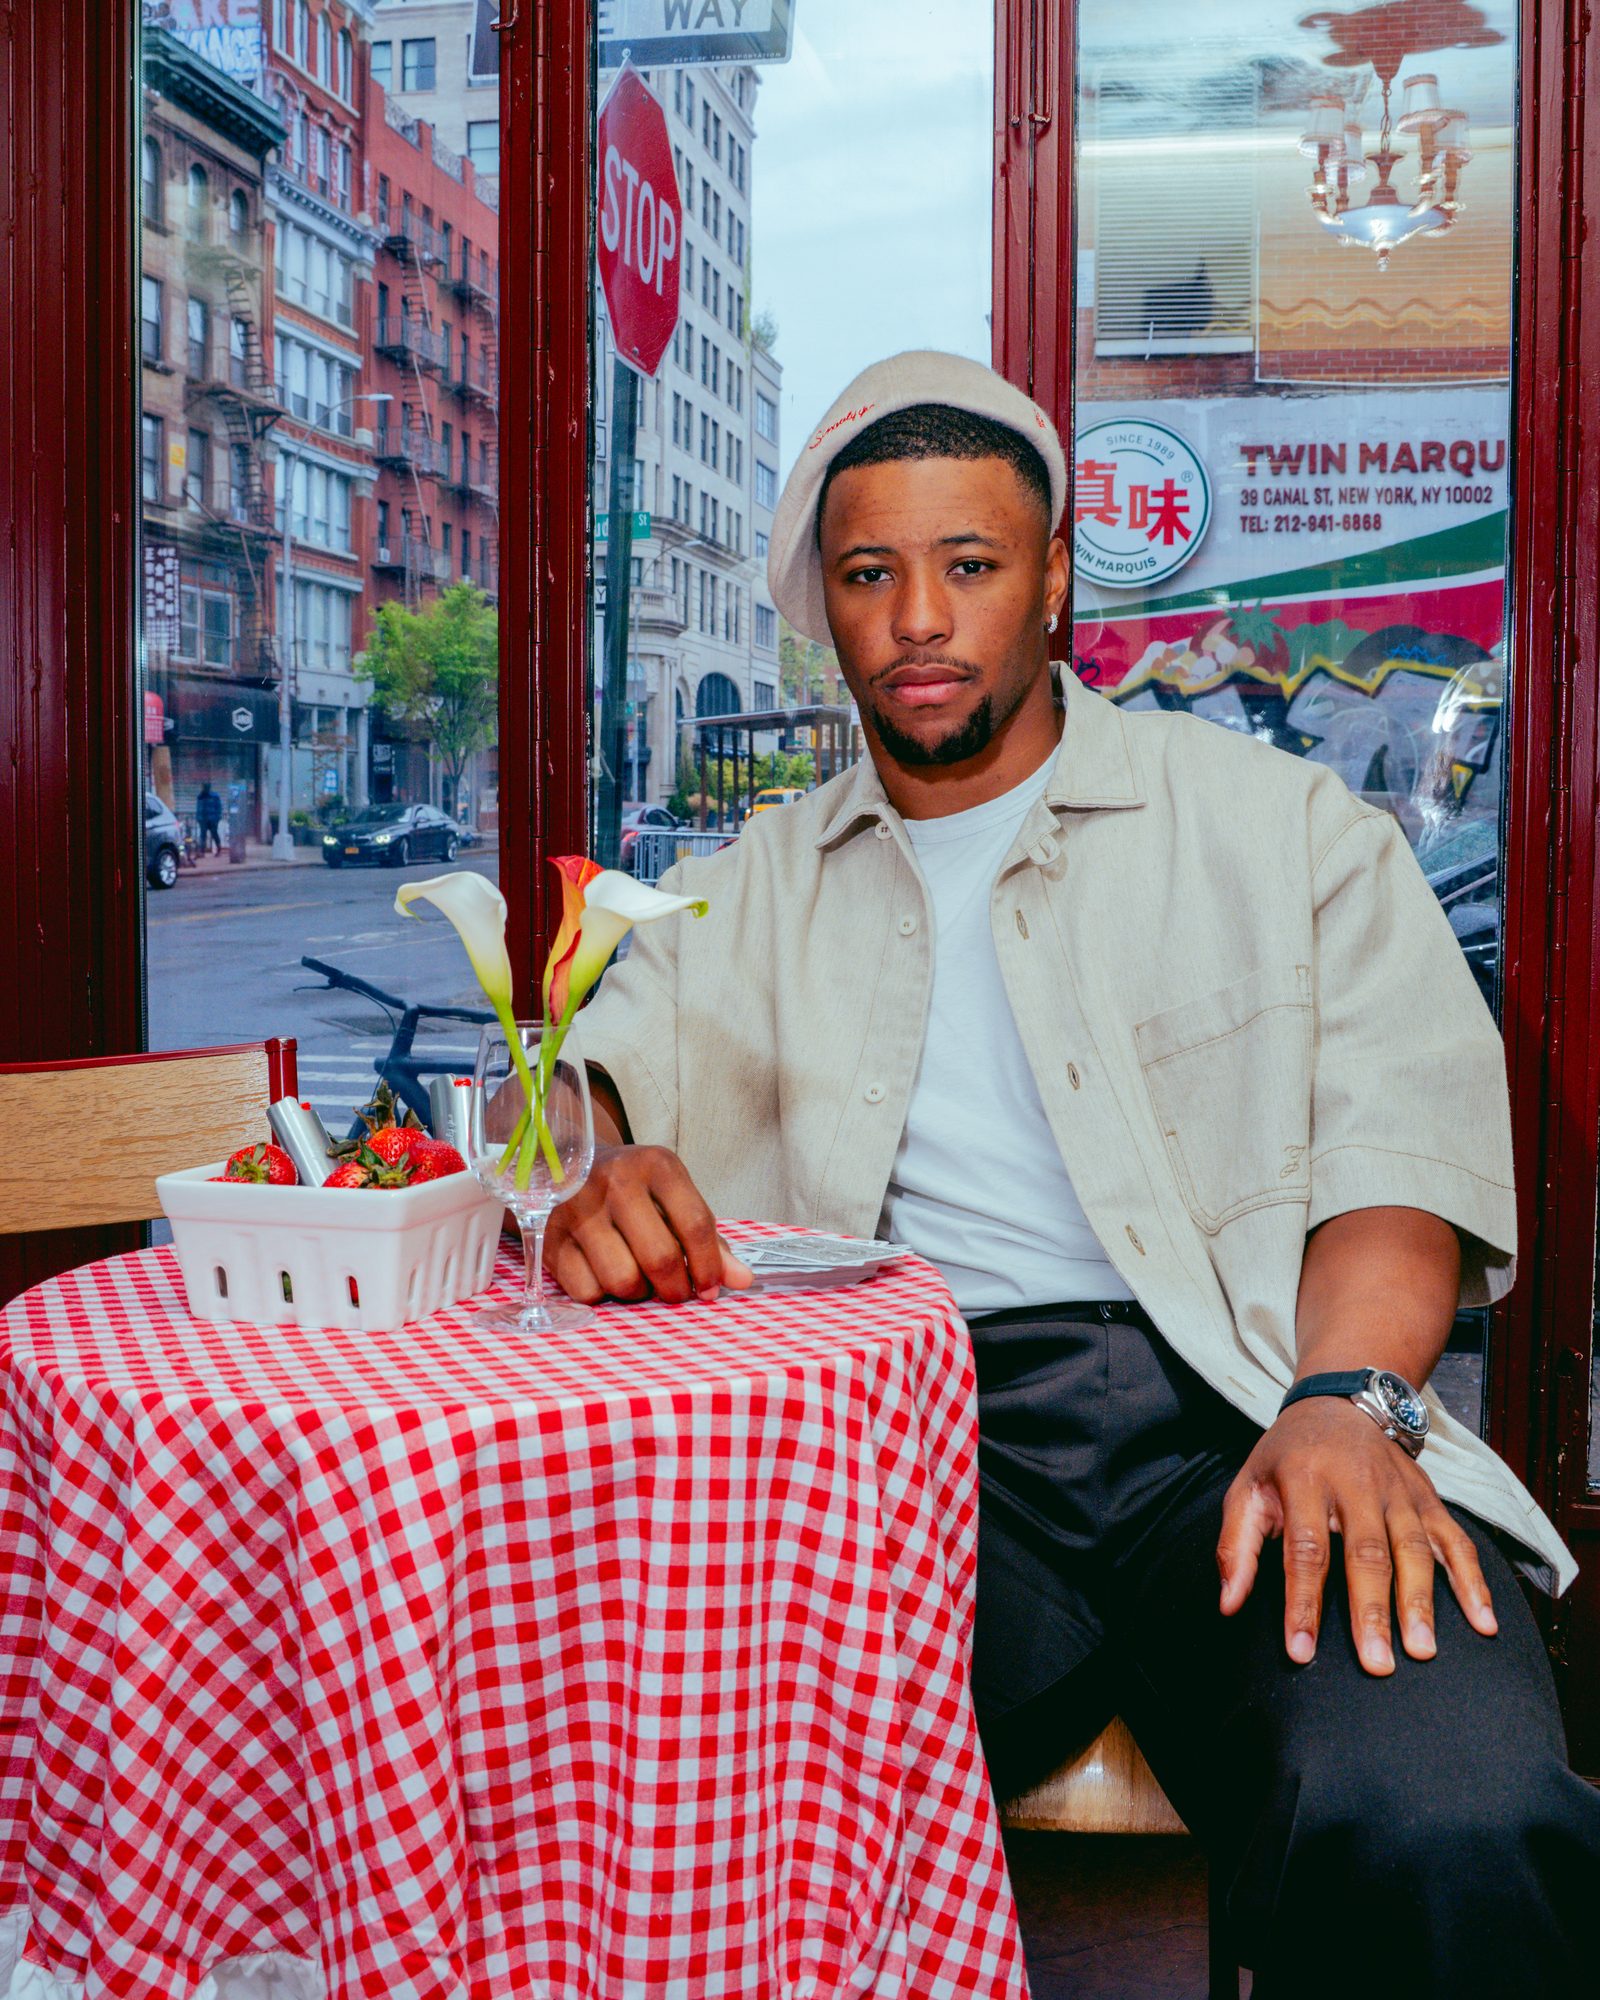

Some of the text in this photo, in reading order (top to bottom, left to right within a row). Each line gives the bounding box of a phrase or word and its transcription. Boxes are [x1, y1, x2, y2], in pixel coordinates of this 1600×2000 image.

[663, 0, 746, 31] WAY
[602, 145, 676, 296] STOP
[1106, 434, 1175, 460] SINCE 1989
[1240, 440, 1505, 477] TWIN MARQU
[1075, 459, 1193, 546] 真味
[1241, 485, 1493, 506] 39 CANAL ST, NEW YORK, NY 10002
[1240, 515, 1269, 533] TEL:
[1075, 541, 1157, 574] WIN MARQUIS
